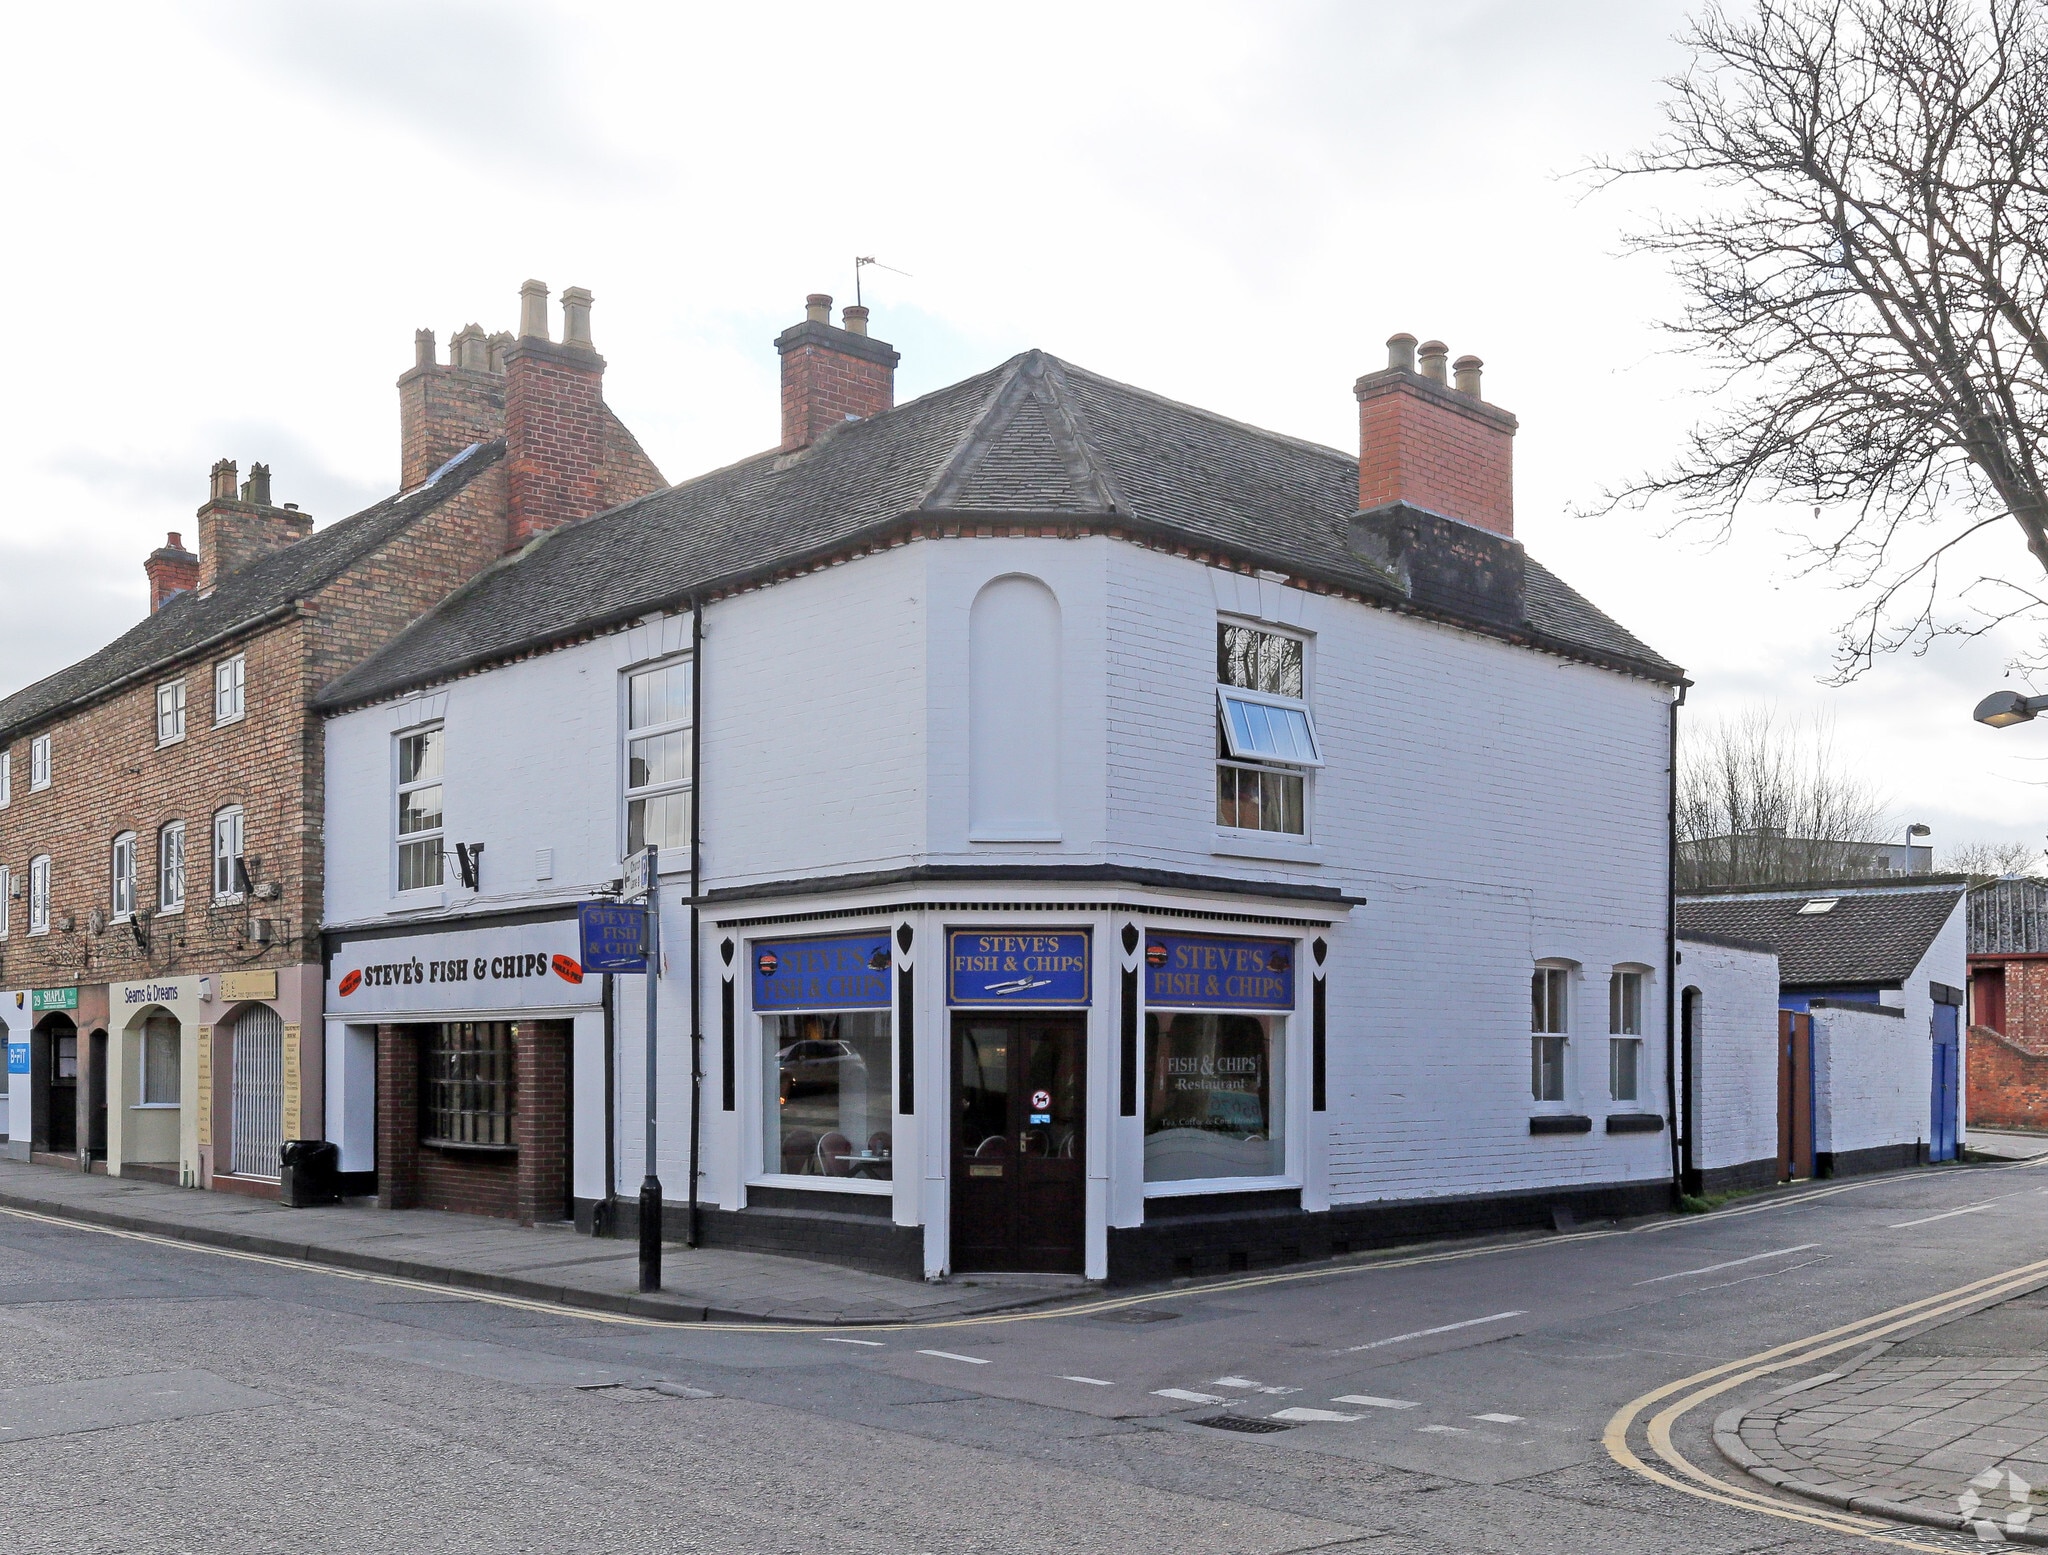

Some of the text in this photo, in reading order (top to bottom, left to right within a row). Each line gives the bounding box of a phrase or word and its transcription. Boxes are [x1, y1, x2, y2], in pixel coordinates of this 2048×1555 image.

[603, 926, 637, 939] FISH
[589, 943, 599, 954] &
[979, 936, 1059, 953] STEVE'S
[954, 956, 1084, 972] FISH & CHIPS
[1175, 945, 1264, 973] STEVE'S
[364, 952, 548, 986] STEVE'S FISH & CHIPS
[125, 984, 178, 1003] Seams & Dreams
[764, 974, 887, 1000] FISH & CHIPS
[1154, 972, 1284, 998] FISH & CHIPS
[34, 996, 41, 1006] 29
[43, 990, 66, 1002] SHAPLA
[1168, 1055, 1256, 1076] FISH & CHIPS
[1178, 1078, 1245, 1090] Restaurant
